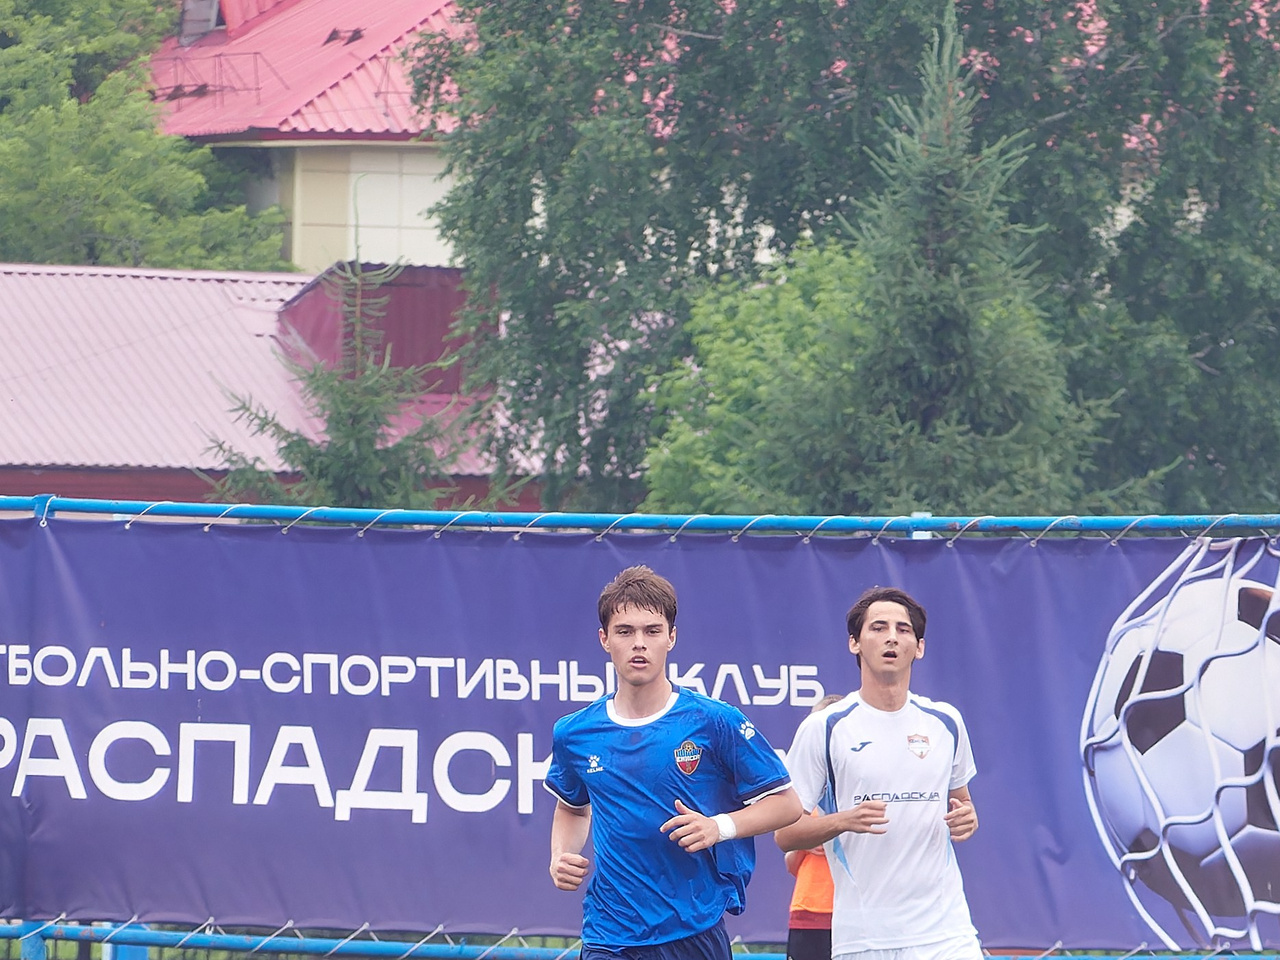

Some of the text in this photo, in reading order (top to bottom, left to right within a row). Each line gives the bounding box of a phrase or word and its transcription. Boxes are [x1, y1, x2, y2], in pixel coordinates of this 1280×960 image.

[0, 644, 825, 707] БОЛЬНО-СПОРТИВНЫ КЛУБ
[0, 717, 553, 823] АСПАДСК
